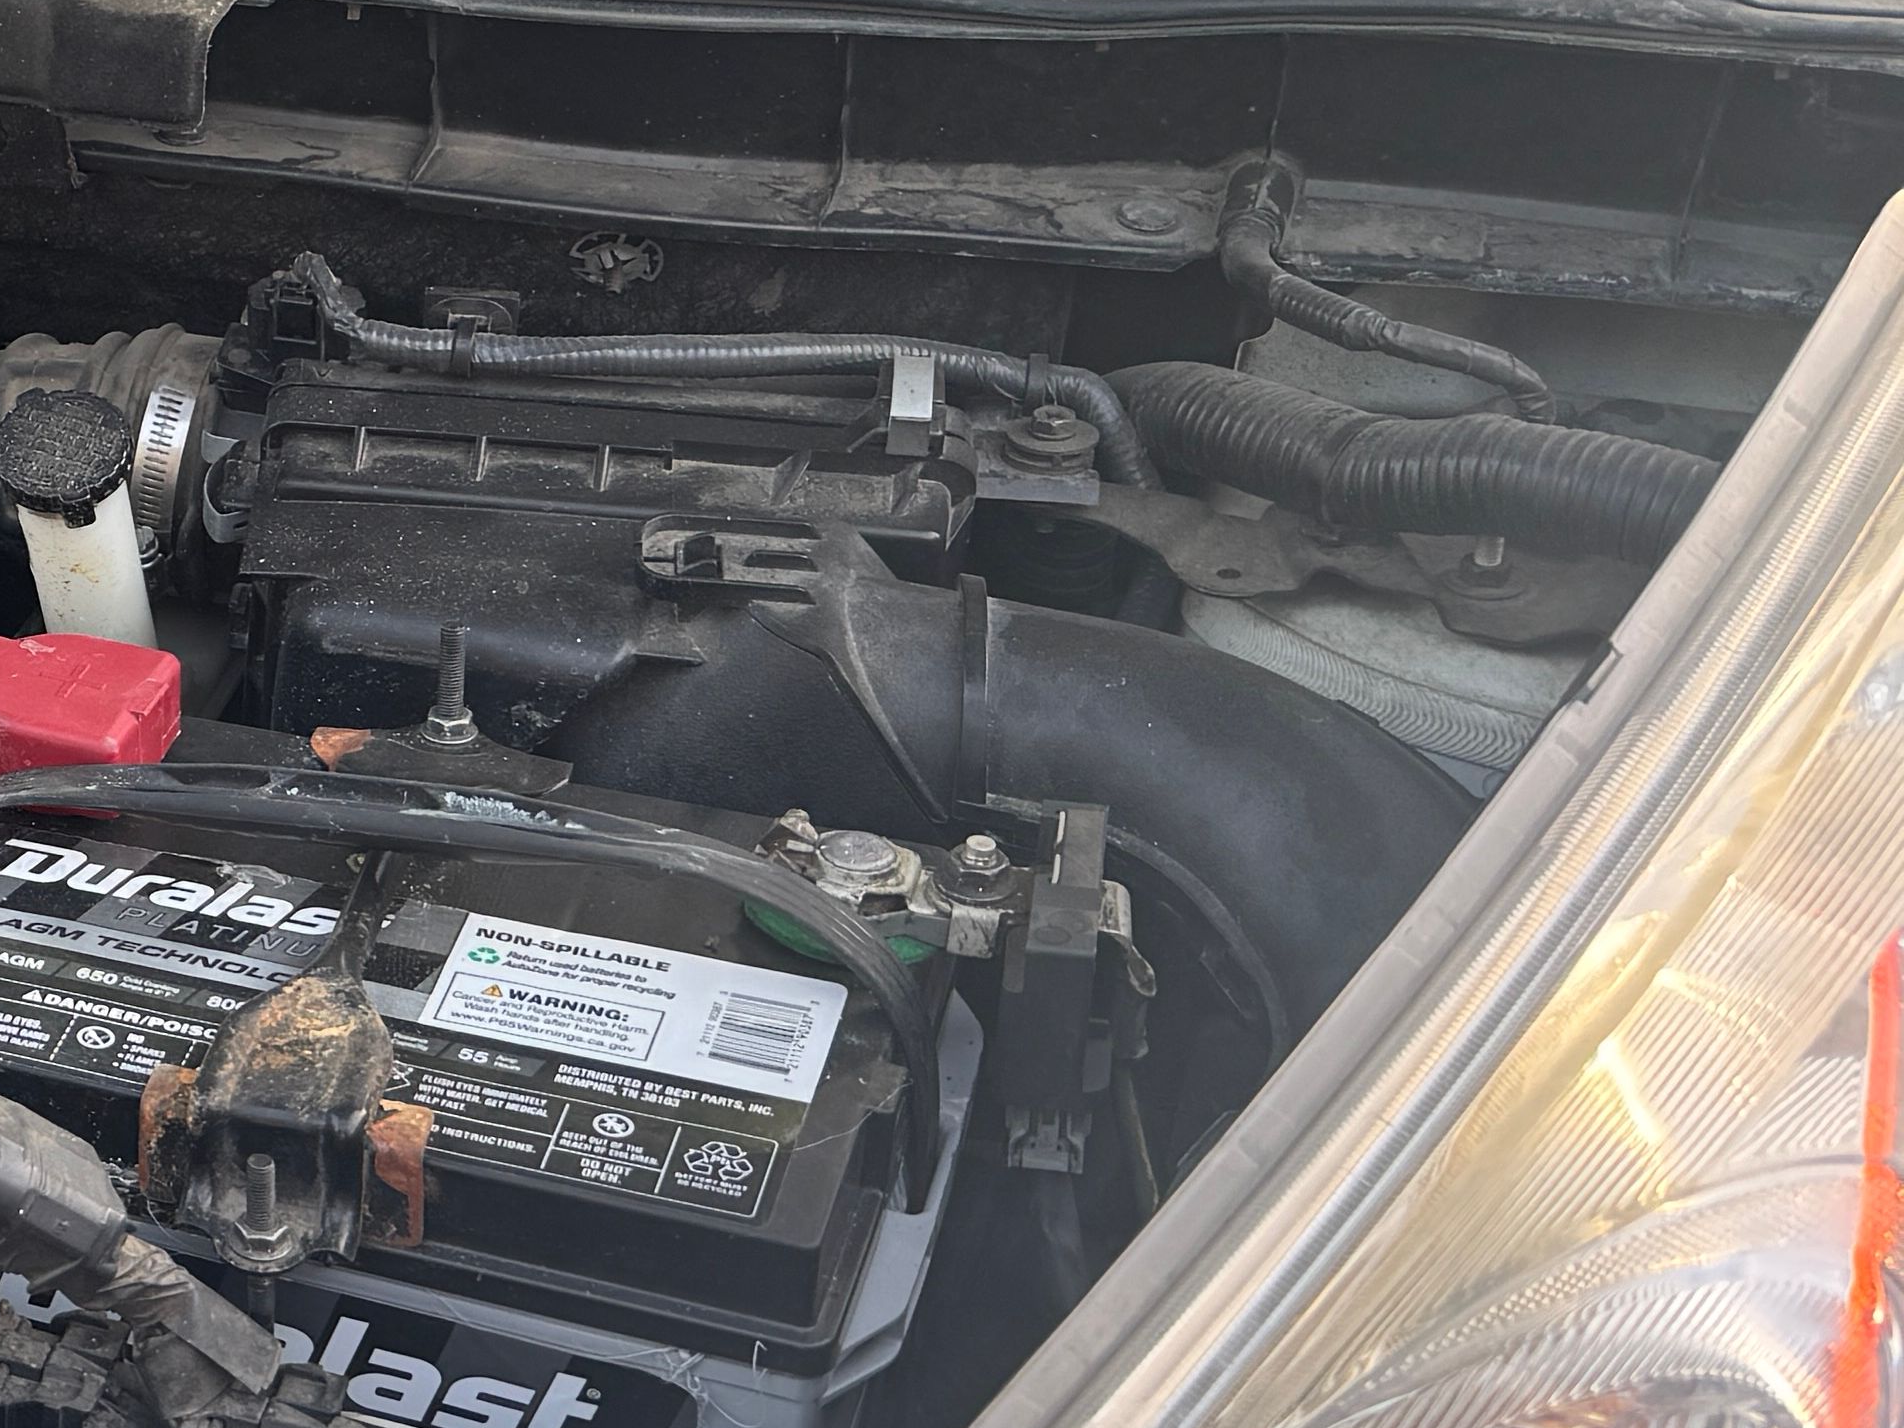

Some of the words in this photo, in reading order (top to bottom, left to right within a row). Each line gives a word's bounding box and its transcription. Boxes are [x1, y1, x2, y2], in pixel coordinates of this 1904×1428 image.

[117, 906, 321, 958] PLATINU
[97, 934, 293, 984] TECHNOLO
[476, 927, 672, 972] NON-SPILLABLE
[76, 967, 119, 986] 650
[502, 959, 559, 978] AutoZone
[562, 970, 579, 981] for
[579, 974, 620, 990] proper
[622, 982, 676, 1000] recycling
[506, 950, 547, 966] Return
[549, 958, 580, 971] used
[581, 964, 632, 982] batteries
[634, 974, 648, 984] to
[43, 993, 219, 1040] DANGER/POISO
[452, 990, 496, 1005] Cancer
[499, 998, 524, 1011] and
[527, 1004, 608, 1028] Reproductive
[464, 1001, 498, 1014] Wash
[501, 1008, 539, 1023] hands
[542, 1017, 572, 1029] after
[508, 988, 630, 1022] WARNING:
[457, 1047, 490, 1063] 55
[413, 1093, 439, 1106] HELP
[418, 1083, 445, 1097] WITH
[484, 1097, 504, 1109] GET
[504, 1102, 548, 1118] MEDICAL
[422, 1074, 455, 1088] FLUSH
[456, 1081, 481, 1093] EYES
[482, 1086, 548, 1107] IMMEDIATELY
[554, 1073, 617, 1096] MEMPHIS,
[621, 1087, 639, 1100] TN
[640, 1091, 680, 1108] 38103
[558, 1063, 642, 1089] DISTRIBUTED
[644, 1082, 662, 1093] BY
[664, 1085, 699, 1101] BEST
[700, 1093, 745, 1112] PARTS,
[748, 1103, 775, 1117] INC.
[442, 1125, 536, 1154] INSTRUCTIONS.
[559, 1138, 592, 1152] REACH
[593, 1145, 607, 1155] OF
[588, 1136, 609, 1147] OUT
[610, 1140, 624, 1151] OF
[580, 1158, 602, 1170] DO
[604, 1163, 634, 1177] NOT
[581, 1167, 622, 1185] OPEN.
